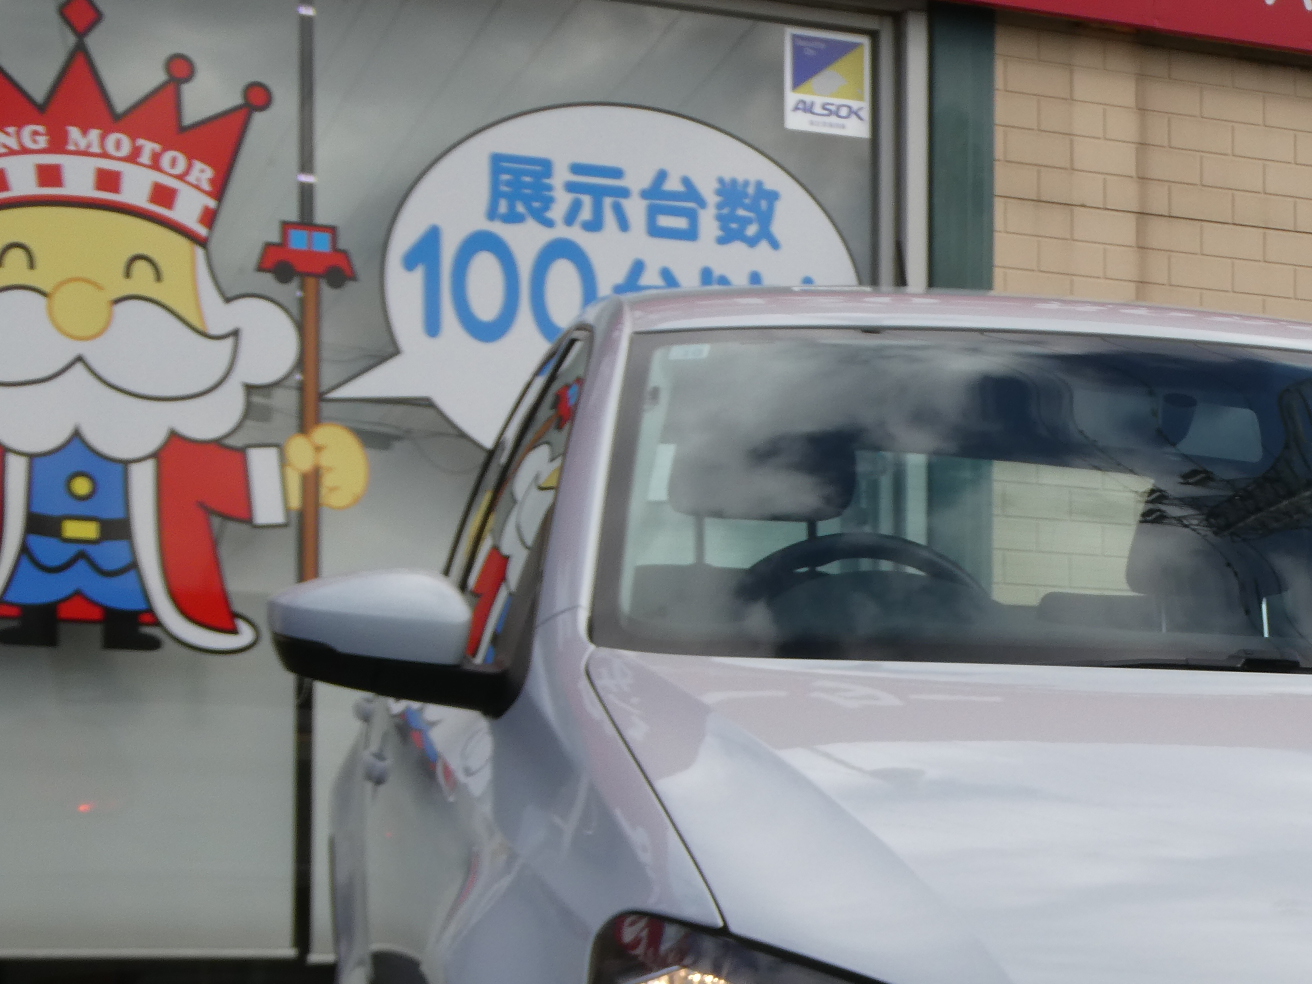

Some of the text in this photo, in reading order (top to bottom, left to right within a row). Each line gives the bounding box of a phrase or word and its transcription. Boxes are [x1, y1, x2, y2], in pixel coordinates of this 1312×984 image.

[792, 99, 865, 121] ALSOK
[65, 126, 215, 191] MOTOR
[485, 152, 781, 250] 展示台数
